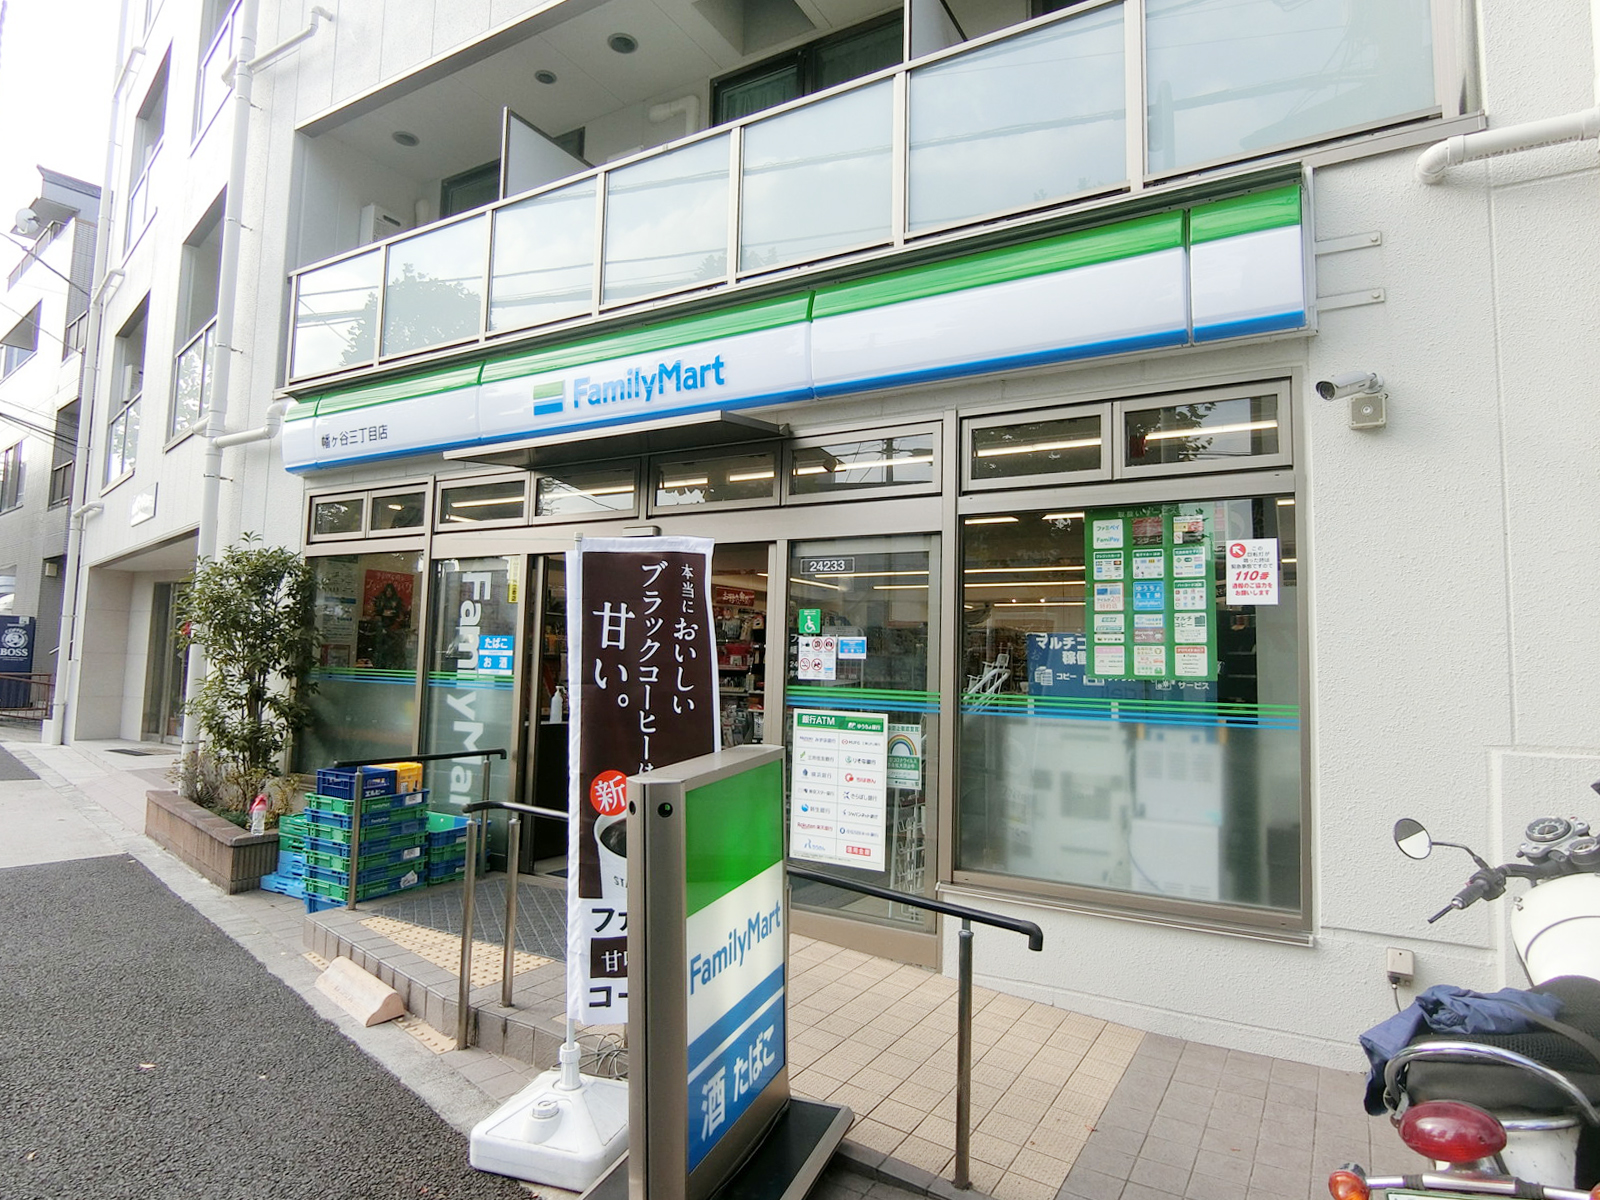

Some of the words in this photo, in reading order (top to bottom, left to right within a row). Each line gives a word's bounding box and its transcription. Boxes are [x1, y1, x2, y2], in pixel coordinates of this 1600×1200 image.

[574, 354, 725, 408] FamilyMart
[321, 424, 388, 449] 幡ヶ谷三丁目店
[809, 560, 845, 571] 24233
[1235, 570, 1270, 581] 110番
[484, 637, 508, 649] たばこ
[673, 563, 699, 715] 本当においしい
[0, 648, 28, 657] BOSS
[592, 601, 636, 708] 甘い。
[1056, 672, 1077, 680] コピー
[1177, 681, 1210, 690] サービス
[801, 714, 836, 725] 銀行ATM
[594, 775, 627, 812] 新
[613, 875, 628, 889] ST
[689, 899, 781, 996] FamilyMart
[601, 949, 628, 973] 甘
[701, 1065, 726, 1142] 酒
[733, 1024, 775, 1102] たばこ
